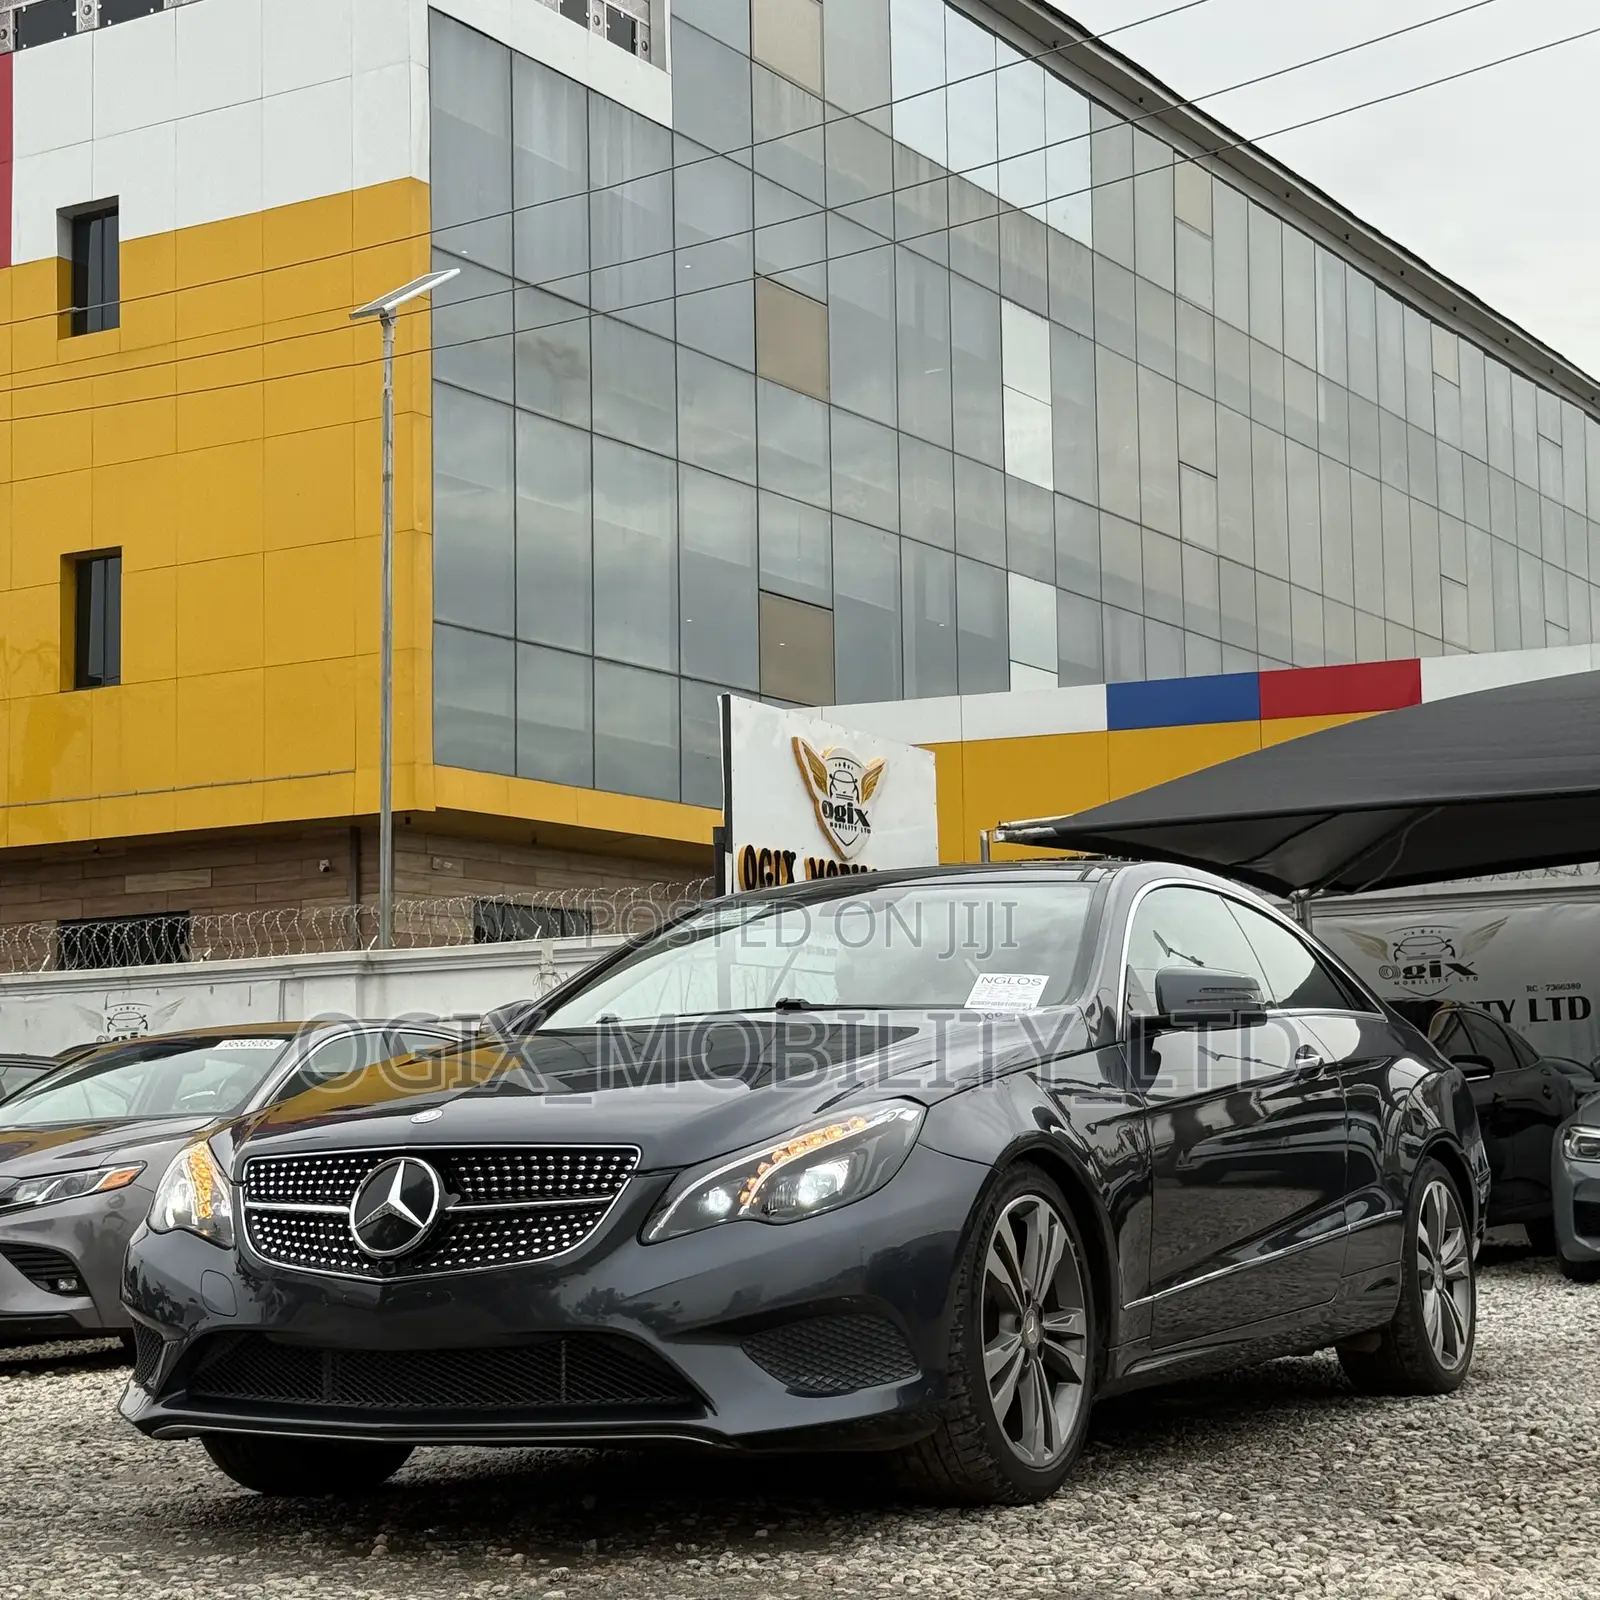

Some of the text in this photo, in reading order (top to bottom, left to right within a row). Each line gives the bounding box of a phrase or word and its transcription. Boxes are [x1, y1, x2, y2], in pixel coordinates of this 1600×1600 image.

[738, 844, 796, 891] OGIX
[981, 976, 1042, 986] NGLOS
[1393, 975, 1479, 986] MOBILITY LTD
[1525, 984, 1539, 993] RC
[1528, 995, 1592, 1023] LTD
